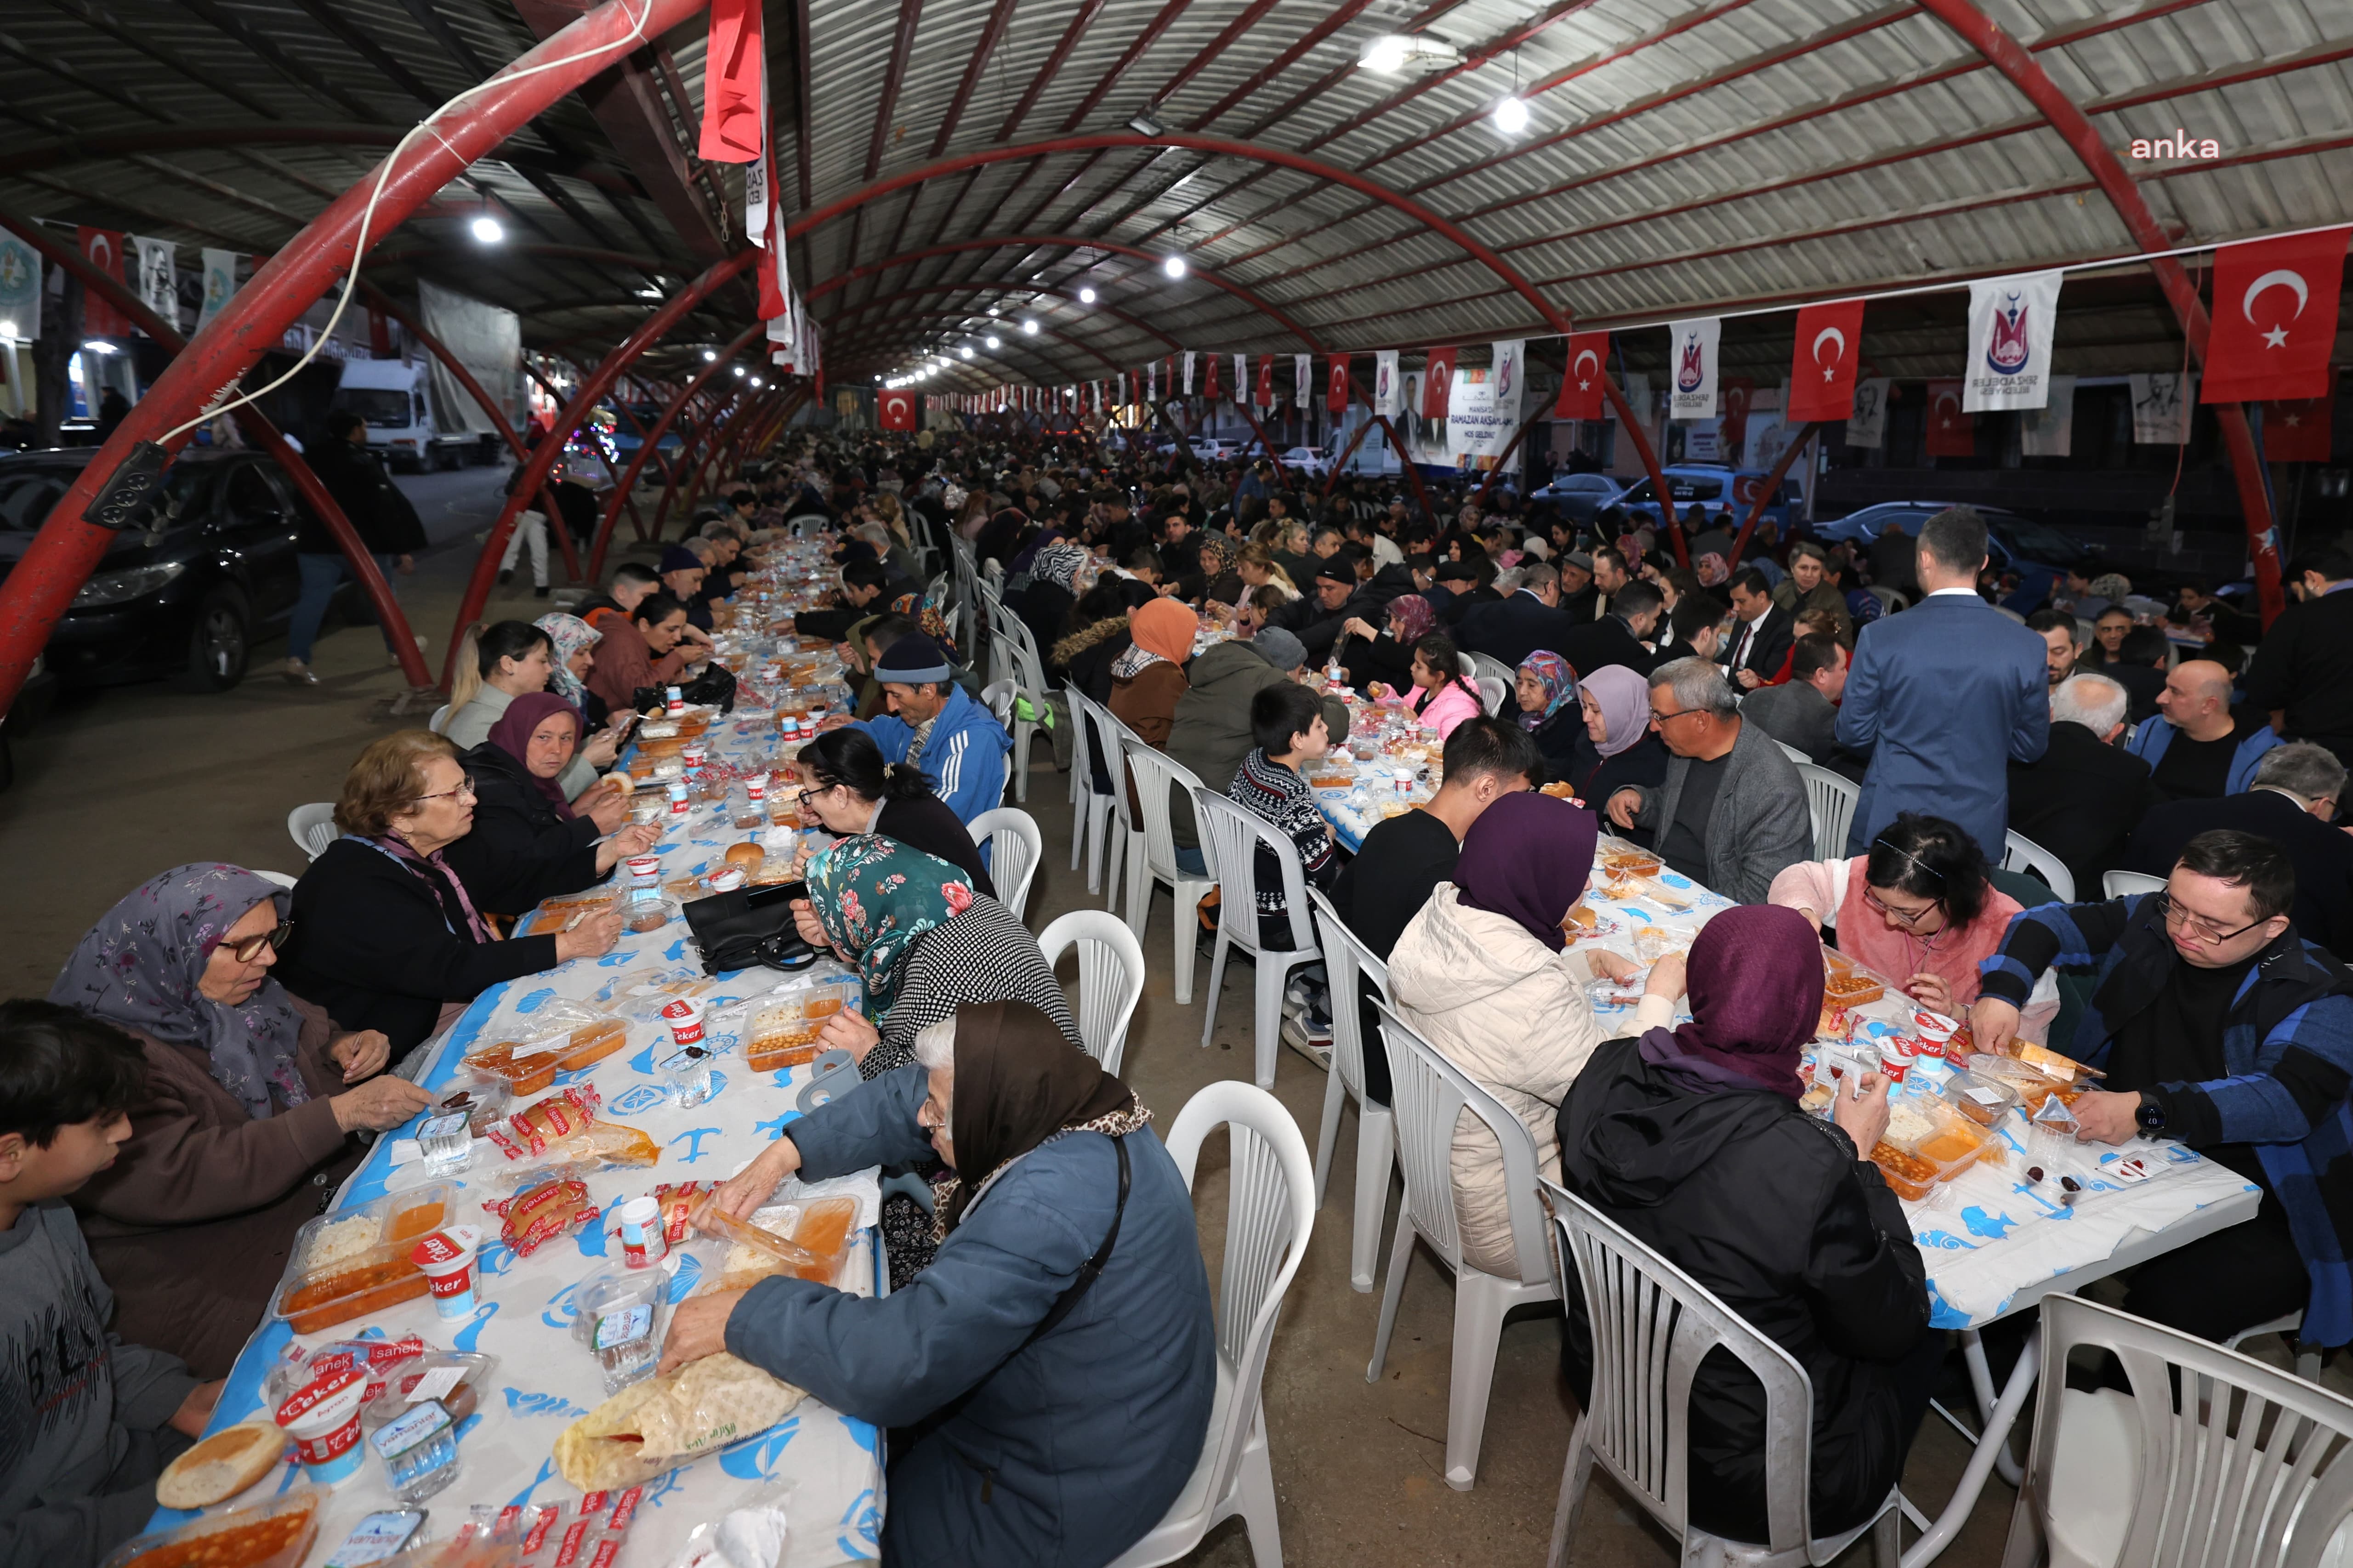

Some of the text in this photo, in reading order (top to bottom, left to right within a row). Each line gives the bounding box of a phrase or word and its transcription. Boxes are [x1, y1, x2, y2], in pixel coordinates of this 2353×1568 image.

[516, 1119, 531, 1134] sanek
[549, 1110, 568, 1134] sanek
[522, 1187, 554, 1212] sanek
[673, 1206, 685, 1237] sanek
[375, 1342, 419, 1358] sanek
[315, 1357, 350, 1375] anek
[615, 1491, 636, 1527] sanek
